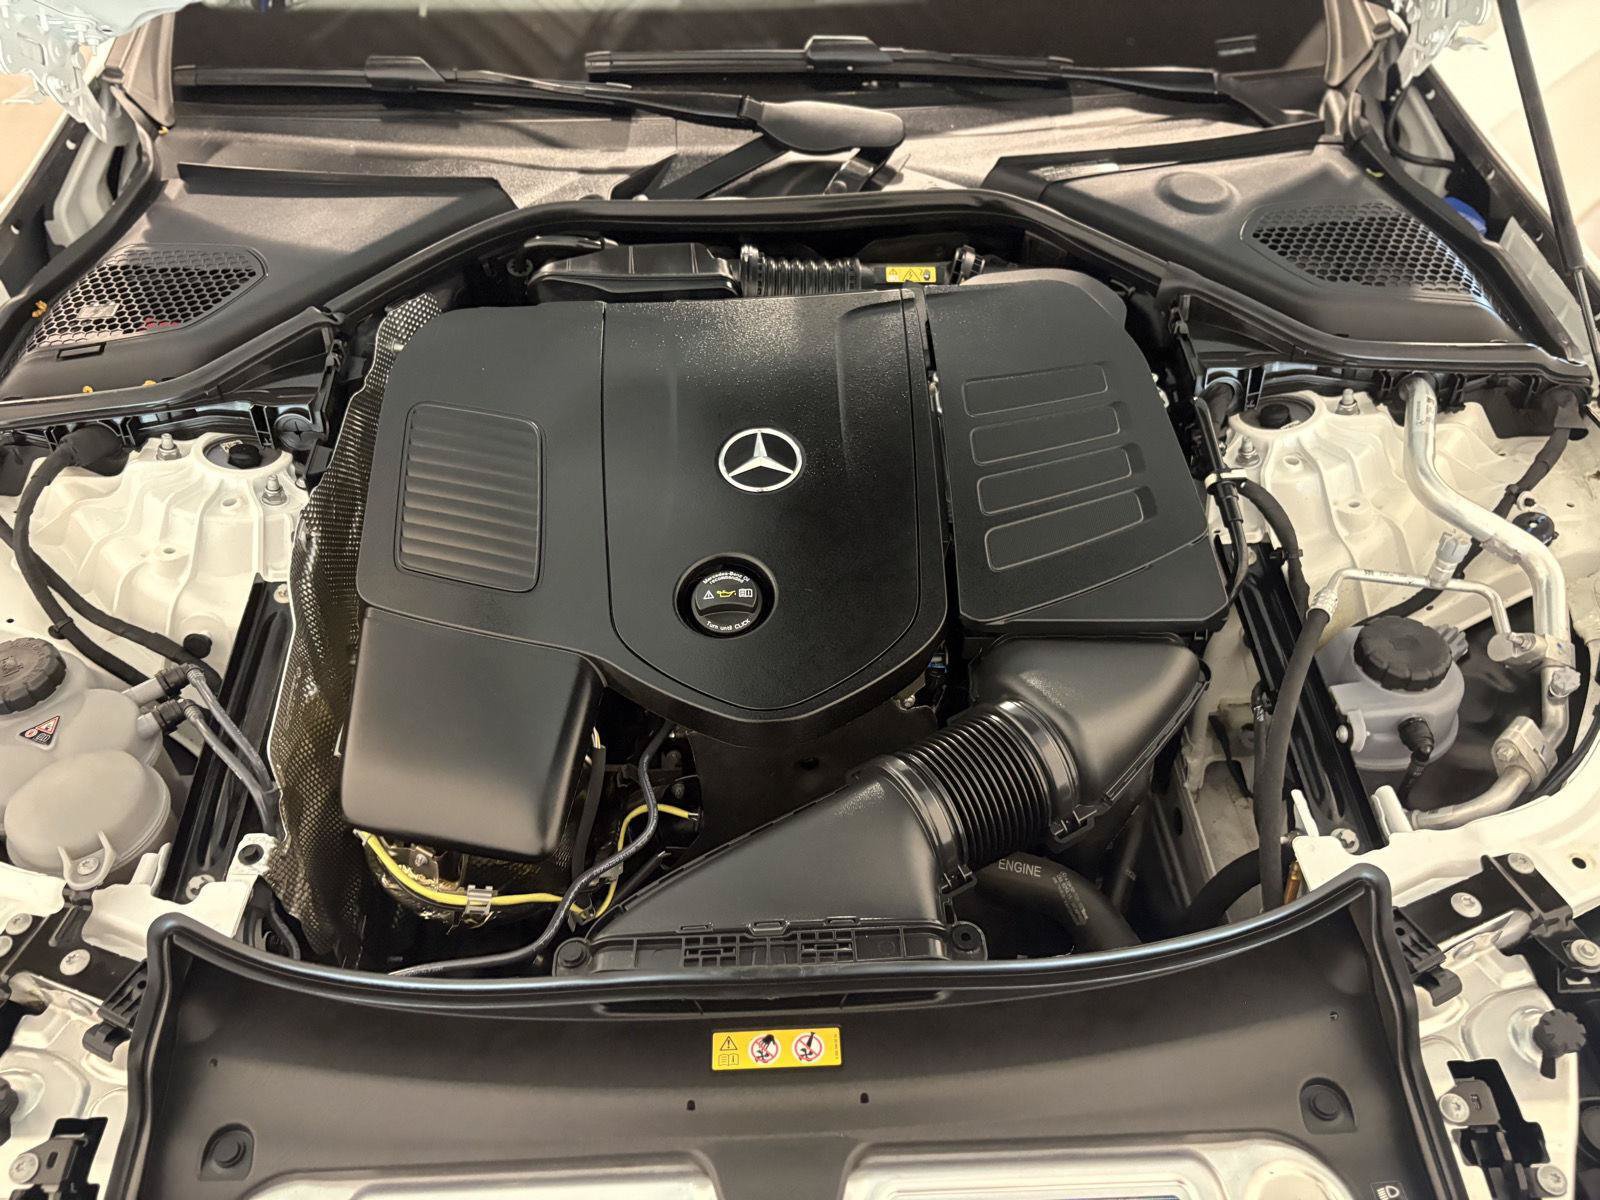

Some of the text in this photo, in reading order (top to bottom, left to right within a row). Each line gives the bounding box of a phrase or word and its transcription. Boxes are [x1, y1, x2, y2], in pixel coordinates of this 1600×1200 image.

[702, 571, 743, 584] Mercedes-Benz
[706, 620, 719, 629] Turn
[734, 619, 750, 629] CLICK
[998, 859, 1042, 877] ENGINE
